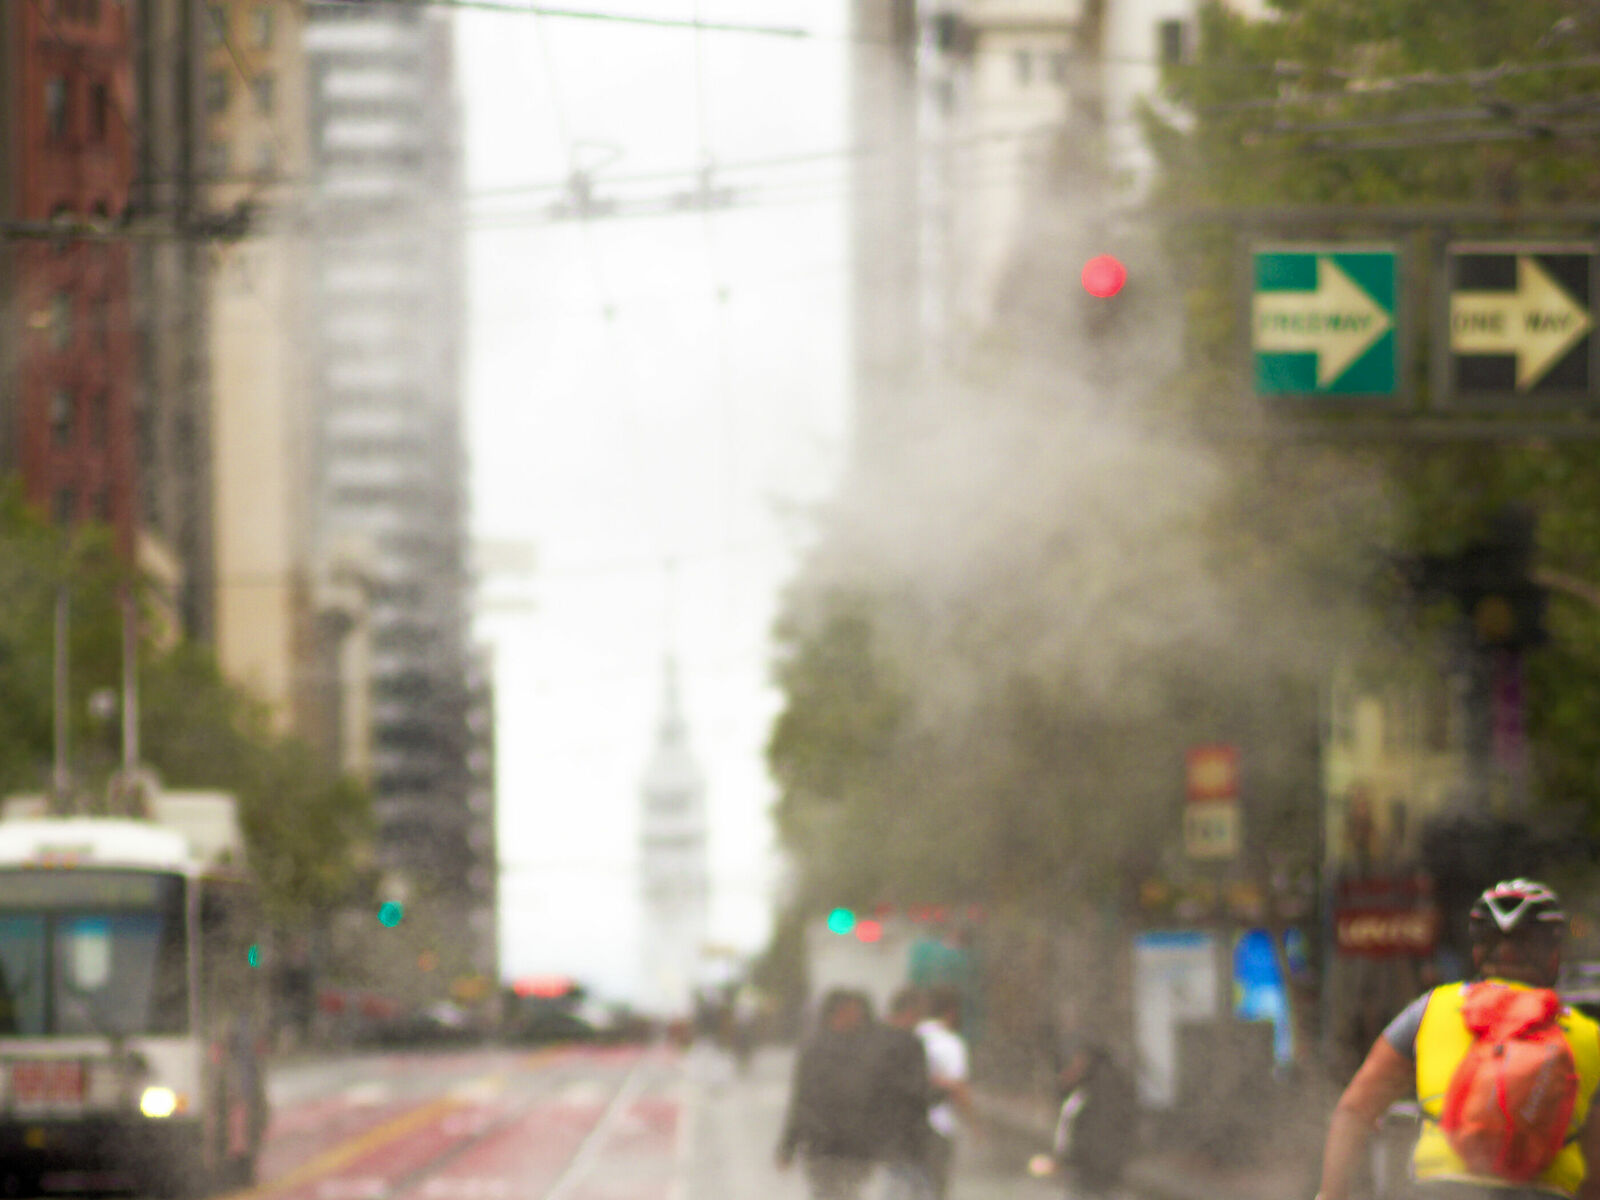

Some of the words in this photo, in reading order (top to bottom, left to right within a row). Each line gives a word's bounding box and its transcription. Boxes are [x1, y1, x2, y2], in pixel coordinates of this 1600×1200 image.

[1260, 311, 1372, 333] FREEWAY
[1453, 311, 1505, 333] ONE
[1523, 311, 1571, 333] WAY
